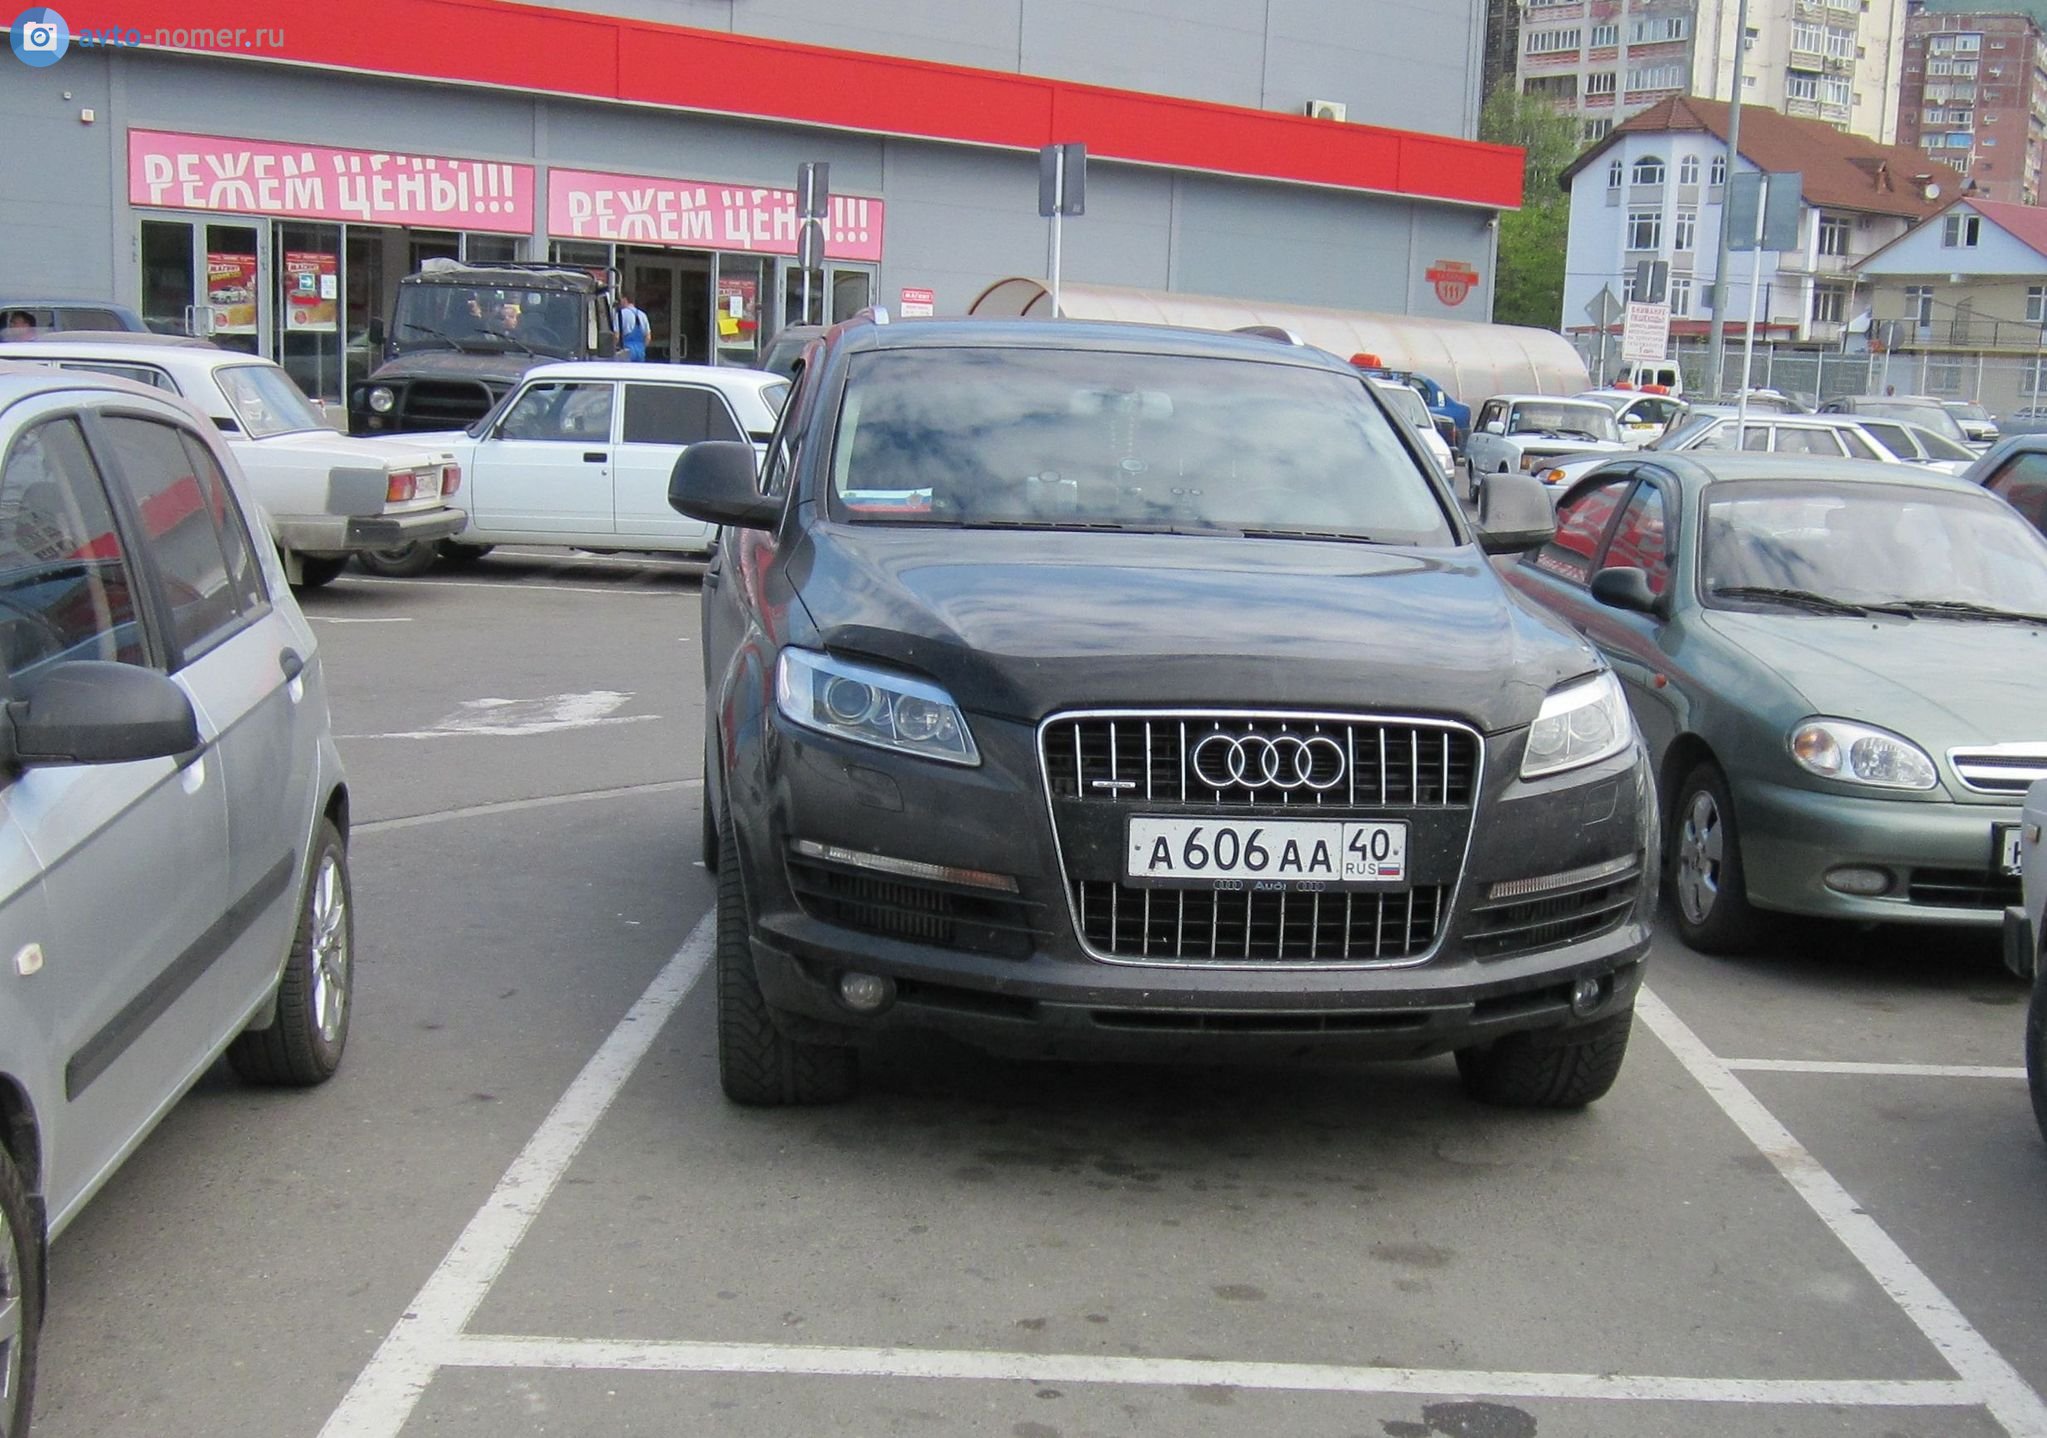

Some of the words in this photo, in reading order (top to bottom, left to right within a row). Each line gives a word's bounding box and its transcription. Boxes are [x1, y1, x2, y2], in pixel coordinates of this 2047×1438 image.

[143, 152, 325, 210] РЕЖЕМ
[333, 154, 515, 221] ЦЕНЫ!!!
[568, 188, 713, 240] РЕЖЕМ
[1348, 828, 1390, 862] 40
[1253, 880, 1287, 891] Audi
[1345, 863, 1377, 875] RUS
